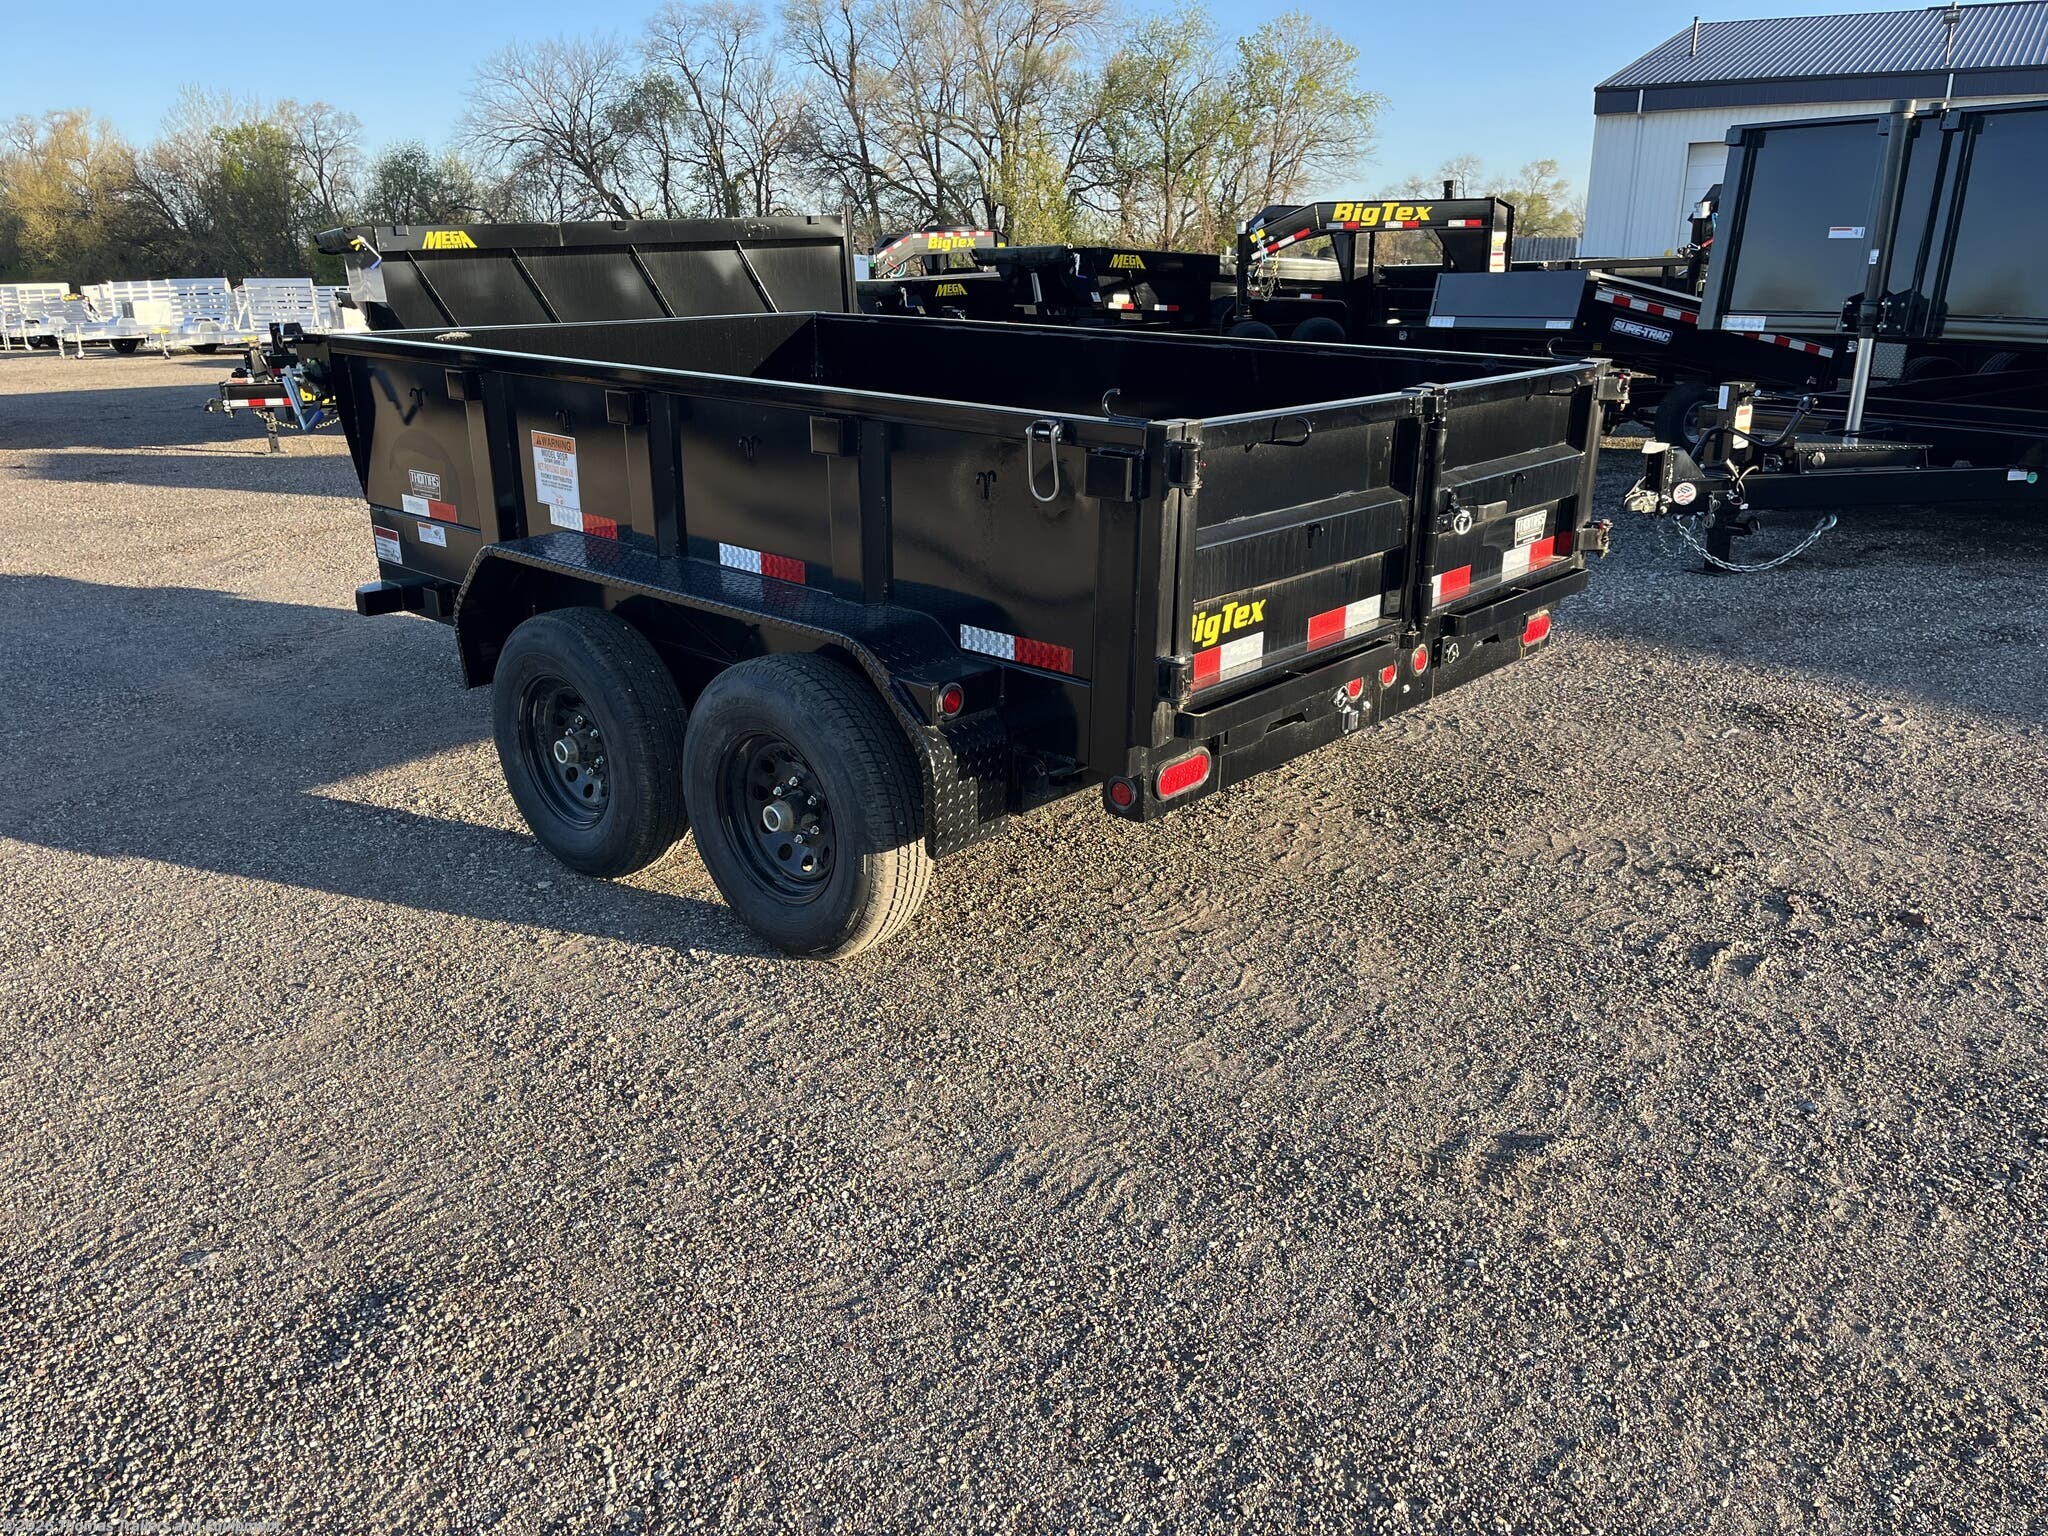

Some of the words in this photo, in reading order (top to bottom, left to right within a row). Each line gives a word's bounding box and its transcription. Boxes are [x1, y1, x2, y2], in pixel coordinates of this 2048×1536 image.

[1332, 202, 1433, 227] BigTex
[422, 230, 478, 249] MEGA
[927, 236, 976, 252] BigTex
[1109, 254, 1146, 270] MEGA
[935, 283, 968, 297] MEGA
[1613, 320, 1670, 342] SURE-TRAC
[541, 436, 571, 451] WARNING
